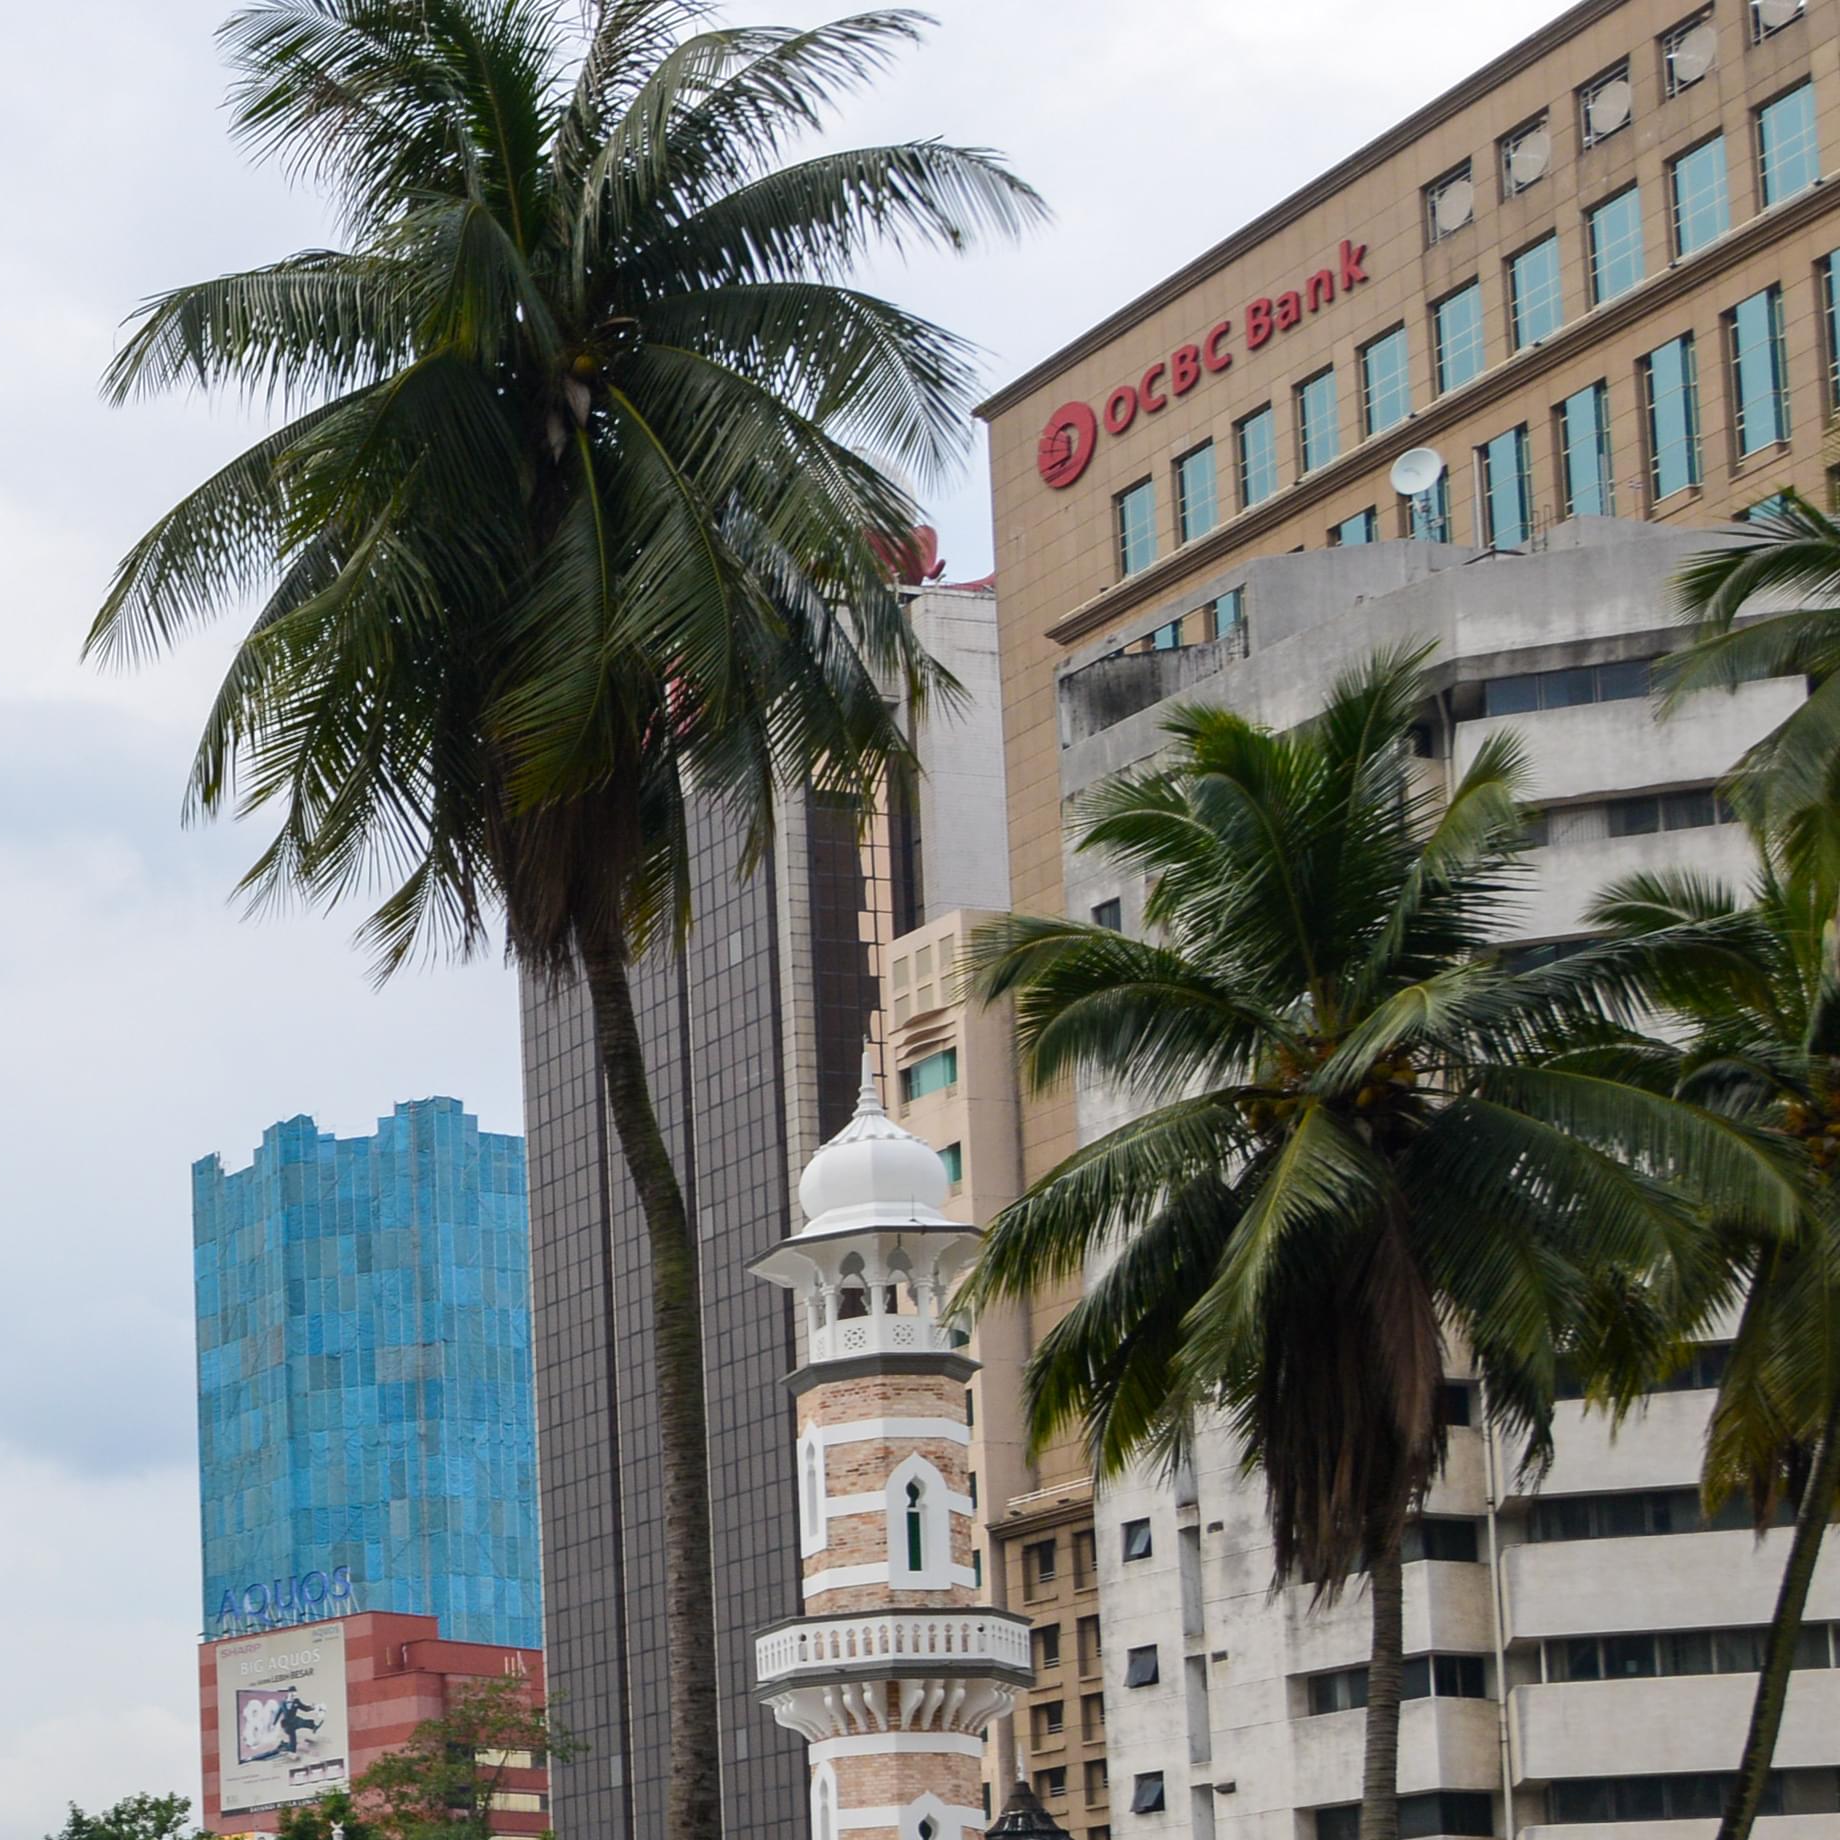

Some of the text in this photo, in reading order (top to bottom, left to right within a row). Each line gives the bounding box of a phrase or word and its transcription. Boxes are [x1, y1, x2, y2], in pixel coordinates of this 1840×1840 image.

[1103, 239, 1369, 435] OCBC Bank
[215, 1565, 351, 1626] AQUOS
[221, 1643, 262, 1658] SHARP
[240, 1648, 321, 1675] BIG AQUOS
